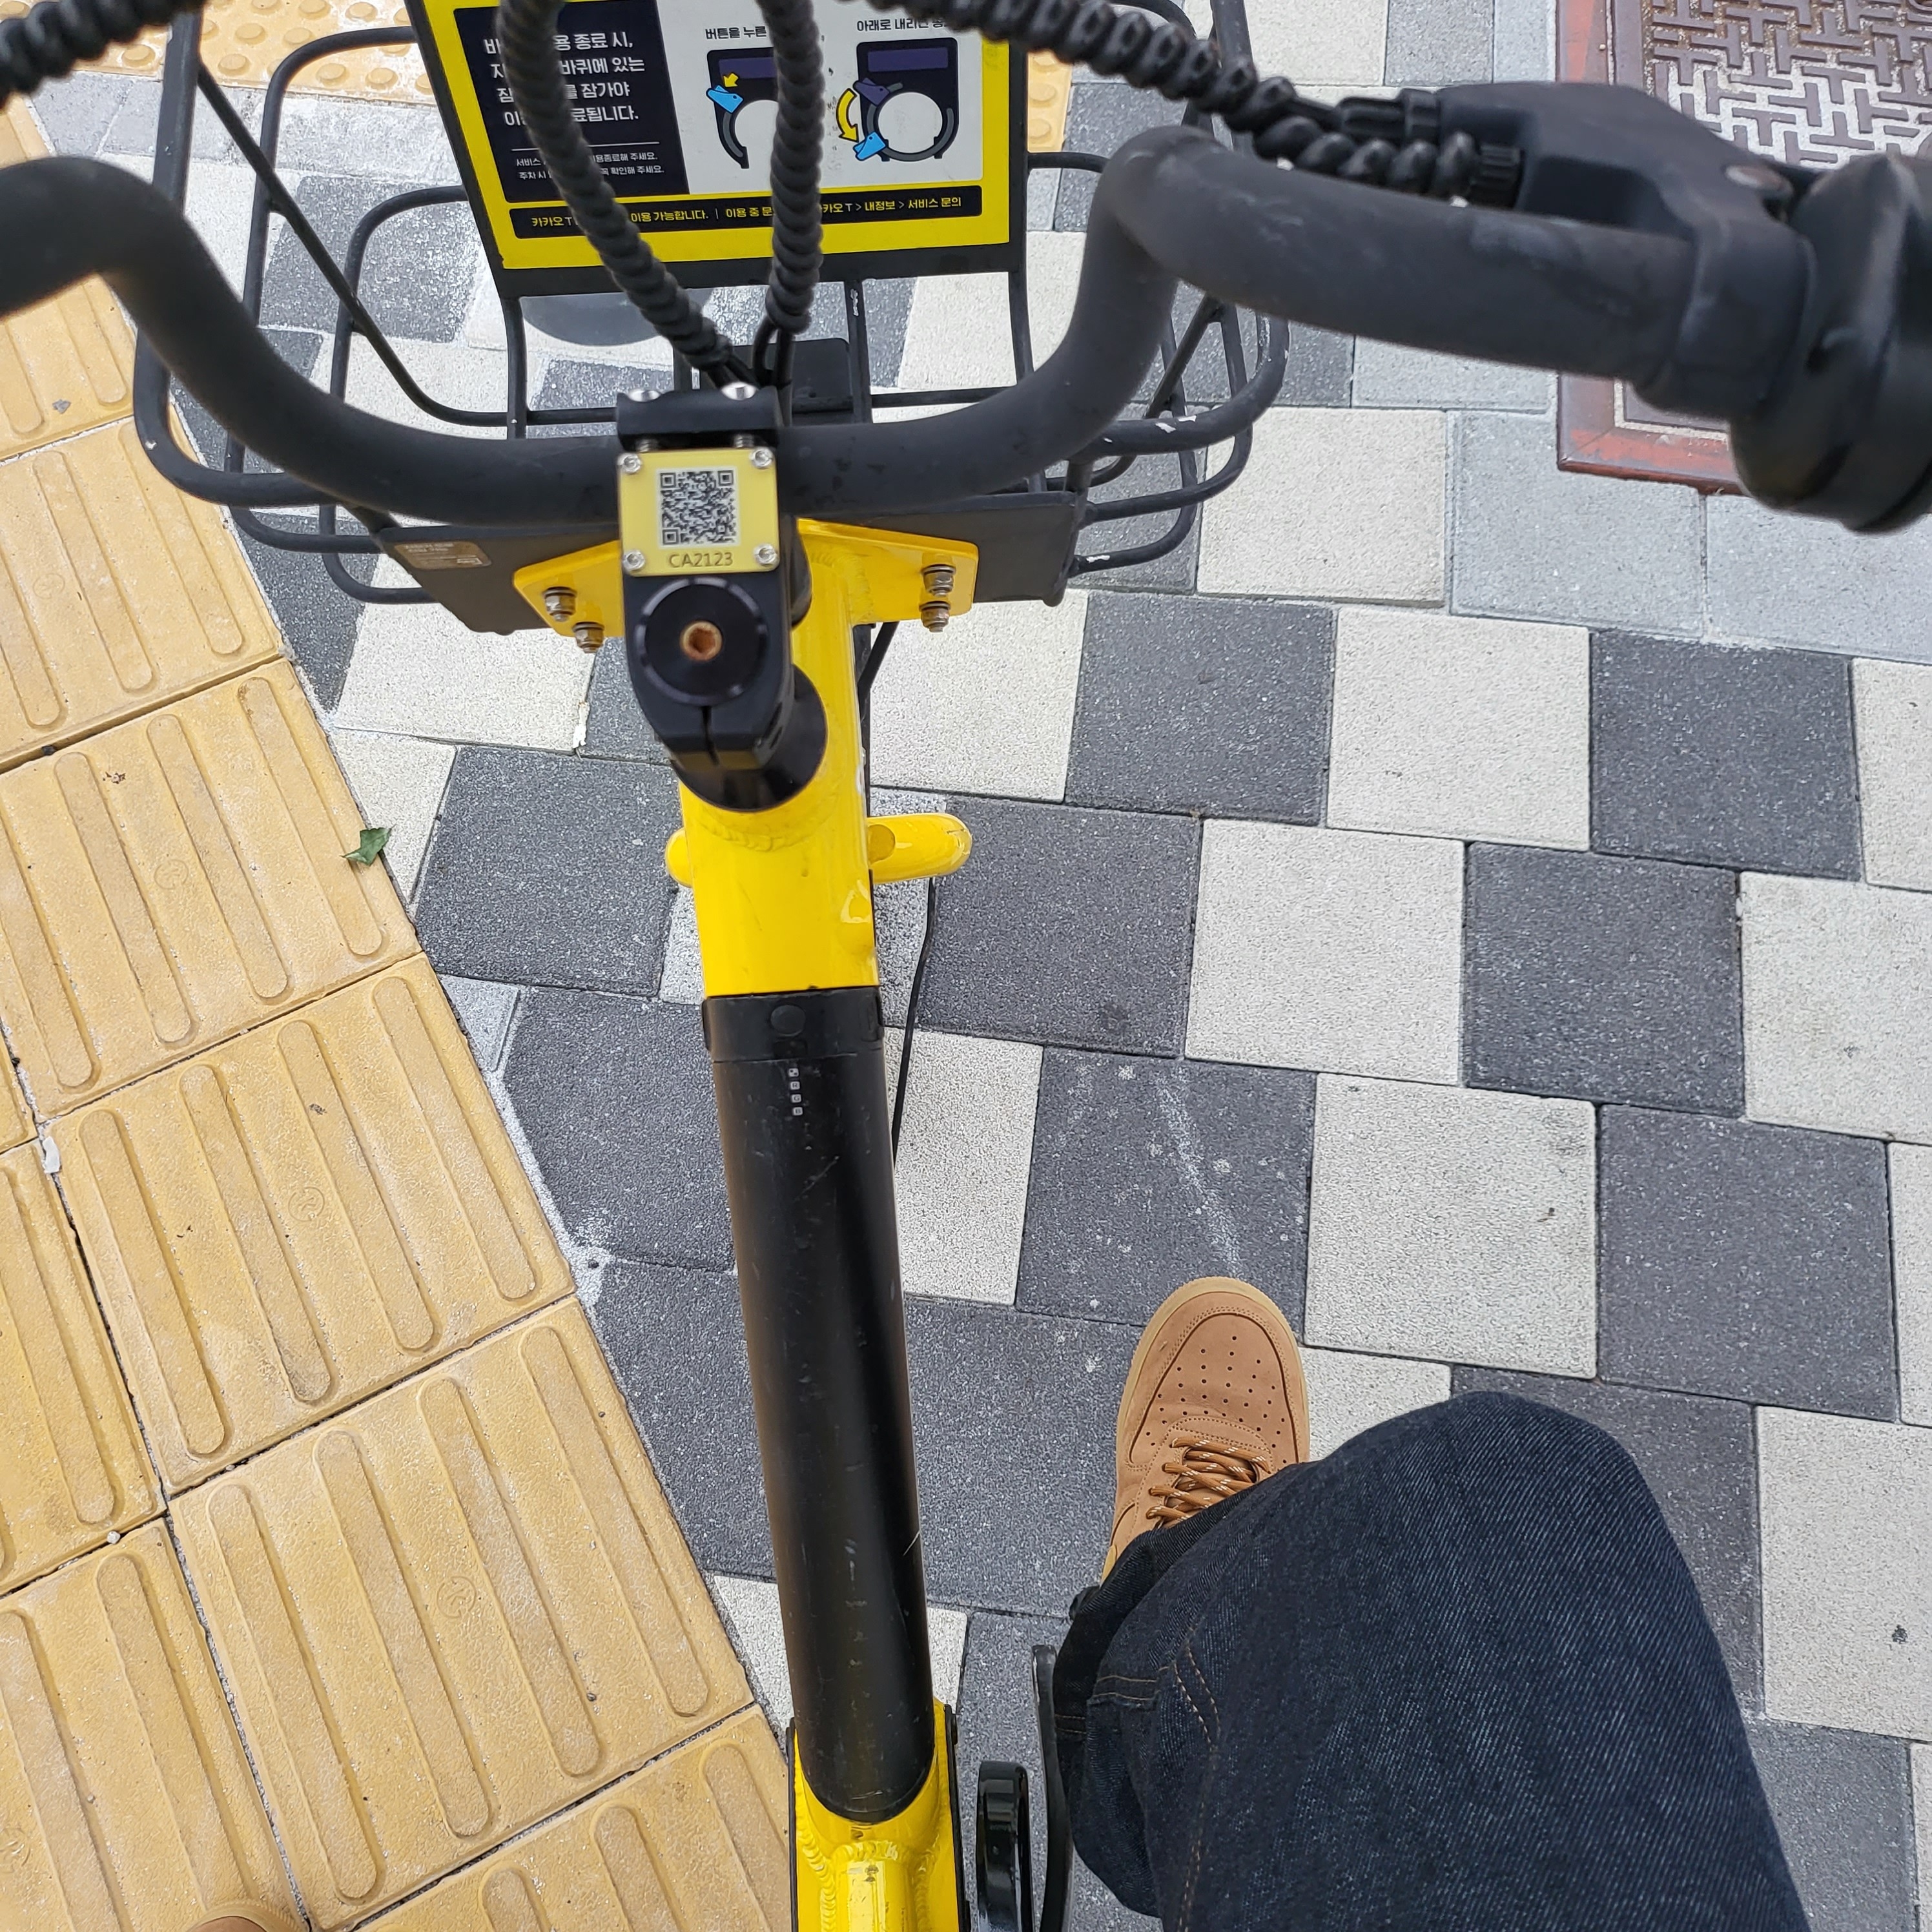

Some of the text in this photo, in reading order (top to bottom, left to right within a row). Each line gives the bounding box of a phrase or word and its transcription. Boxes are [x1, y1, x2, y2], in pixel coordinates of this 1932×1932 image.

[705, 25, 767, 40] 버튼을 누른
[857, 19, 892, 32] 아래로
[553, 31, 633, 52] 용 종료 시,
[612, 56, 645, 73] 있는
[581, 81, 631, 98] 잠가야
[571, 105, 639, 122] 료됩니다.
[516, 158, 541, 167] 서비스
[630, 152, 658, 161] 주세요.
[519, 171, 537, 180] 주차
[539, 170, 546, 179] 시
[610, 166, 635, 176] 확인해
[637, 165, 664, 174] 주세요.
[726, 208, 746, 218] 이용
[749, 207, 760, 217] 중
[817, 203, 844, 213] 카오
[845, 203, 853, 212] T
[865, 201, 896, 211] 내정보
[908, 198, 939, 209] 서비스
[941, 196, 961, 207] 문의
[531, 216, 564, 227] 카카오
[564, 216, 572, 226] T
[630, 210, 709, 222] 이용 가능합니다.
[668, 551, 734, 568] CA2123
